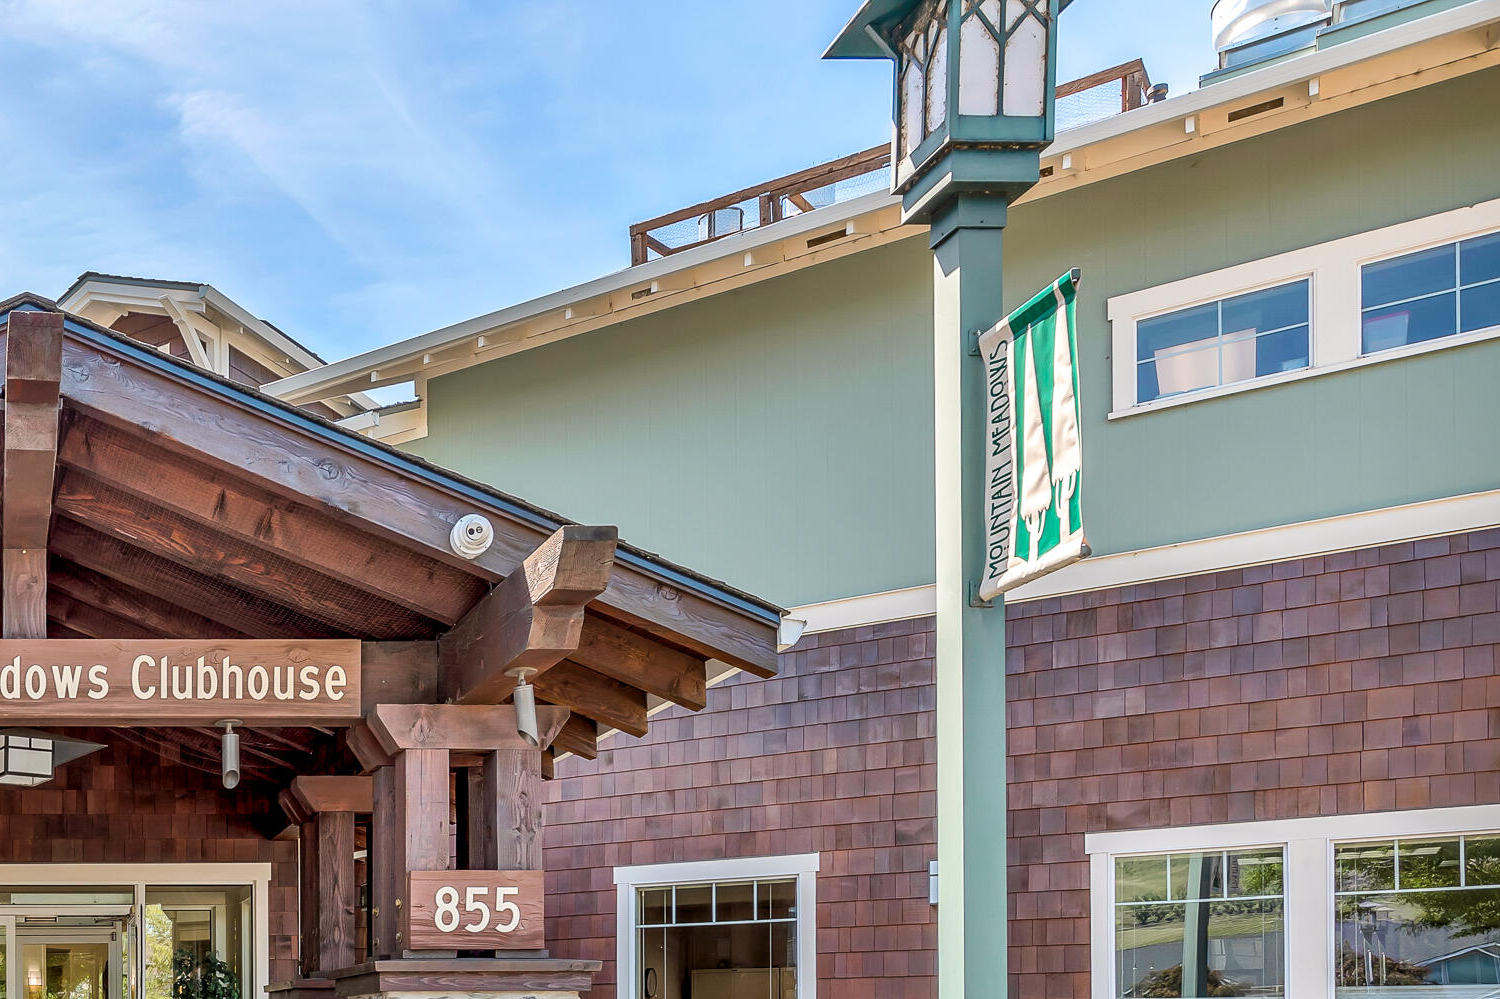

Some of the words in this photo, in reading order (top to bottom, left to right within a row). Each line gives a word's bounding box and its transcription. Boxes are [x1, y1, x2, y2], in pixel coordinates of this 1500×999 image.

[989, 339, 1011, 456] MEADOWS
[989, 460, 1012, 579] MOUNTAIN
[131, 654, 347, 700] Clubhouse
[434, 886, 521, 933] 855
